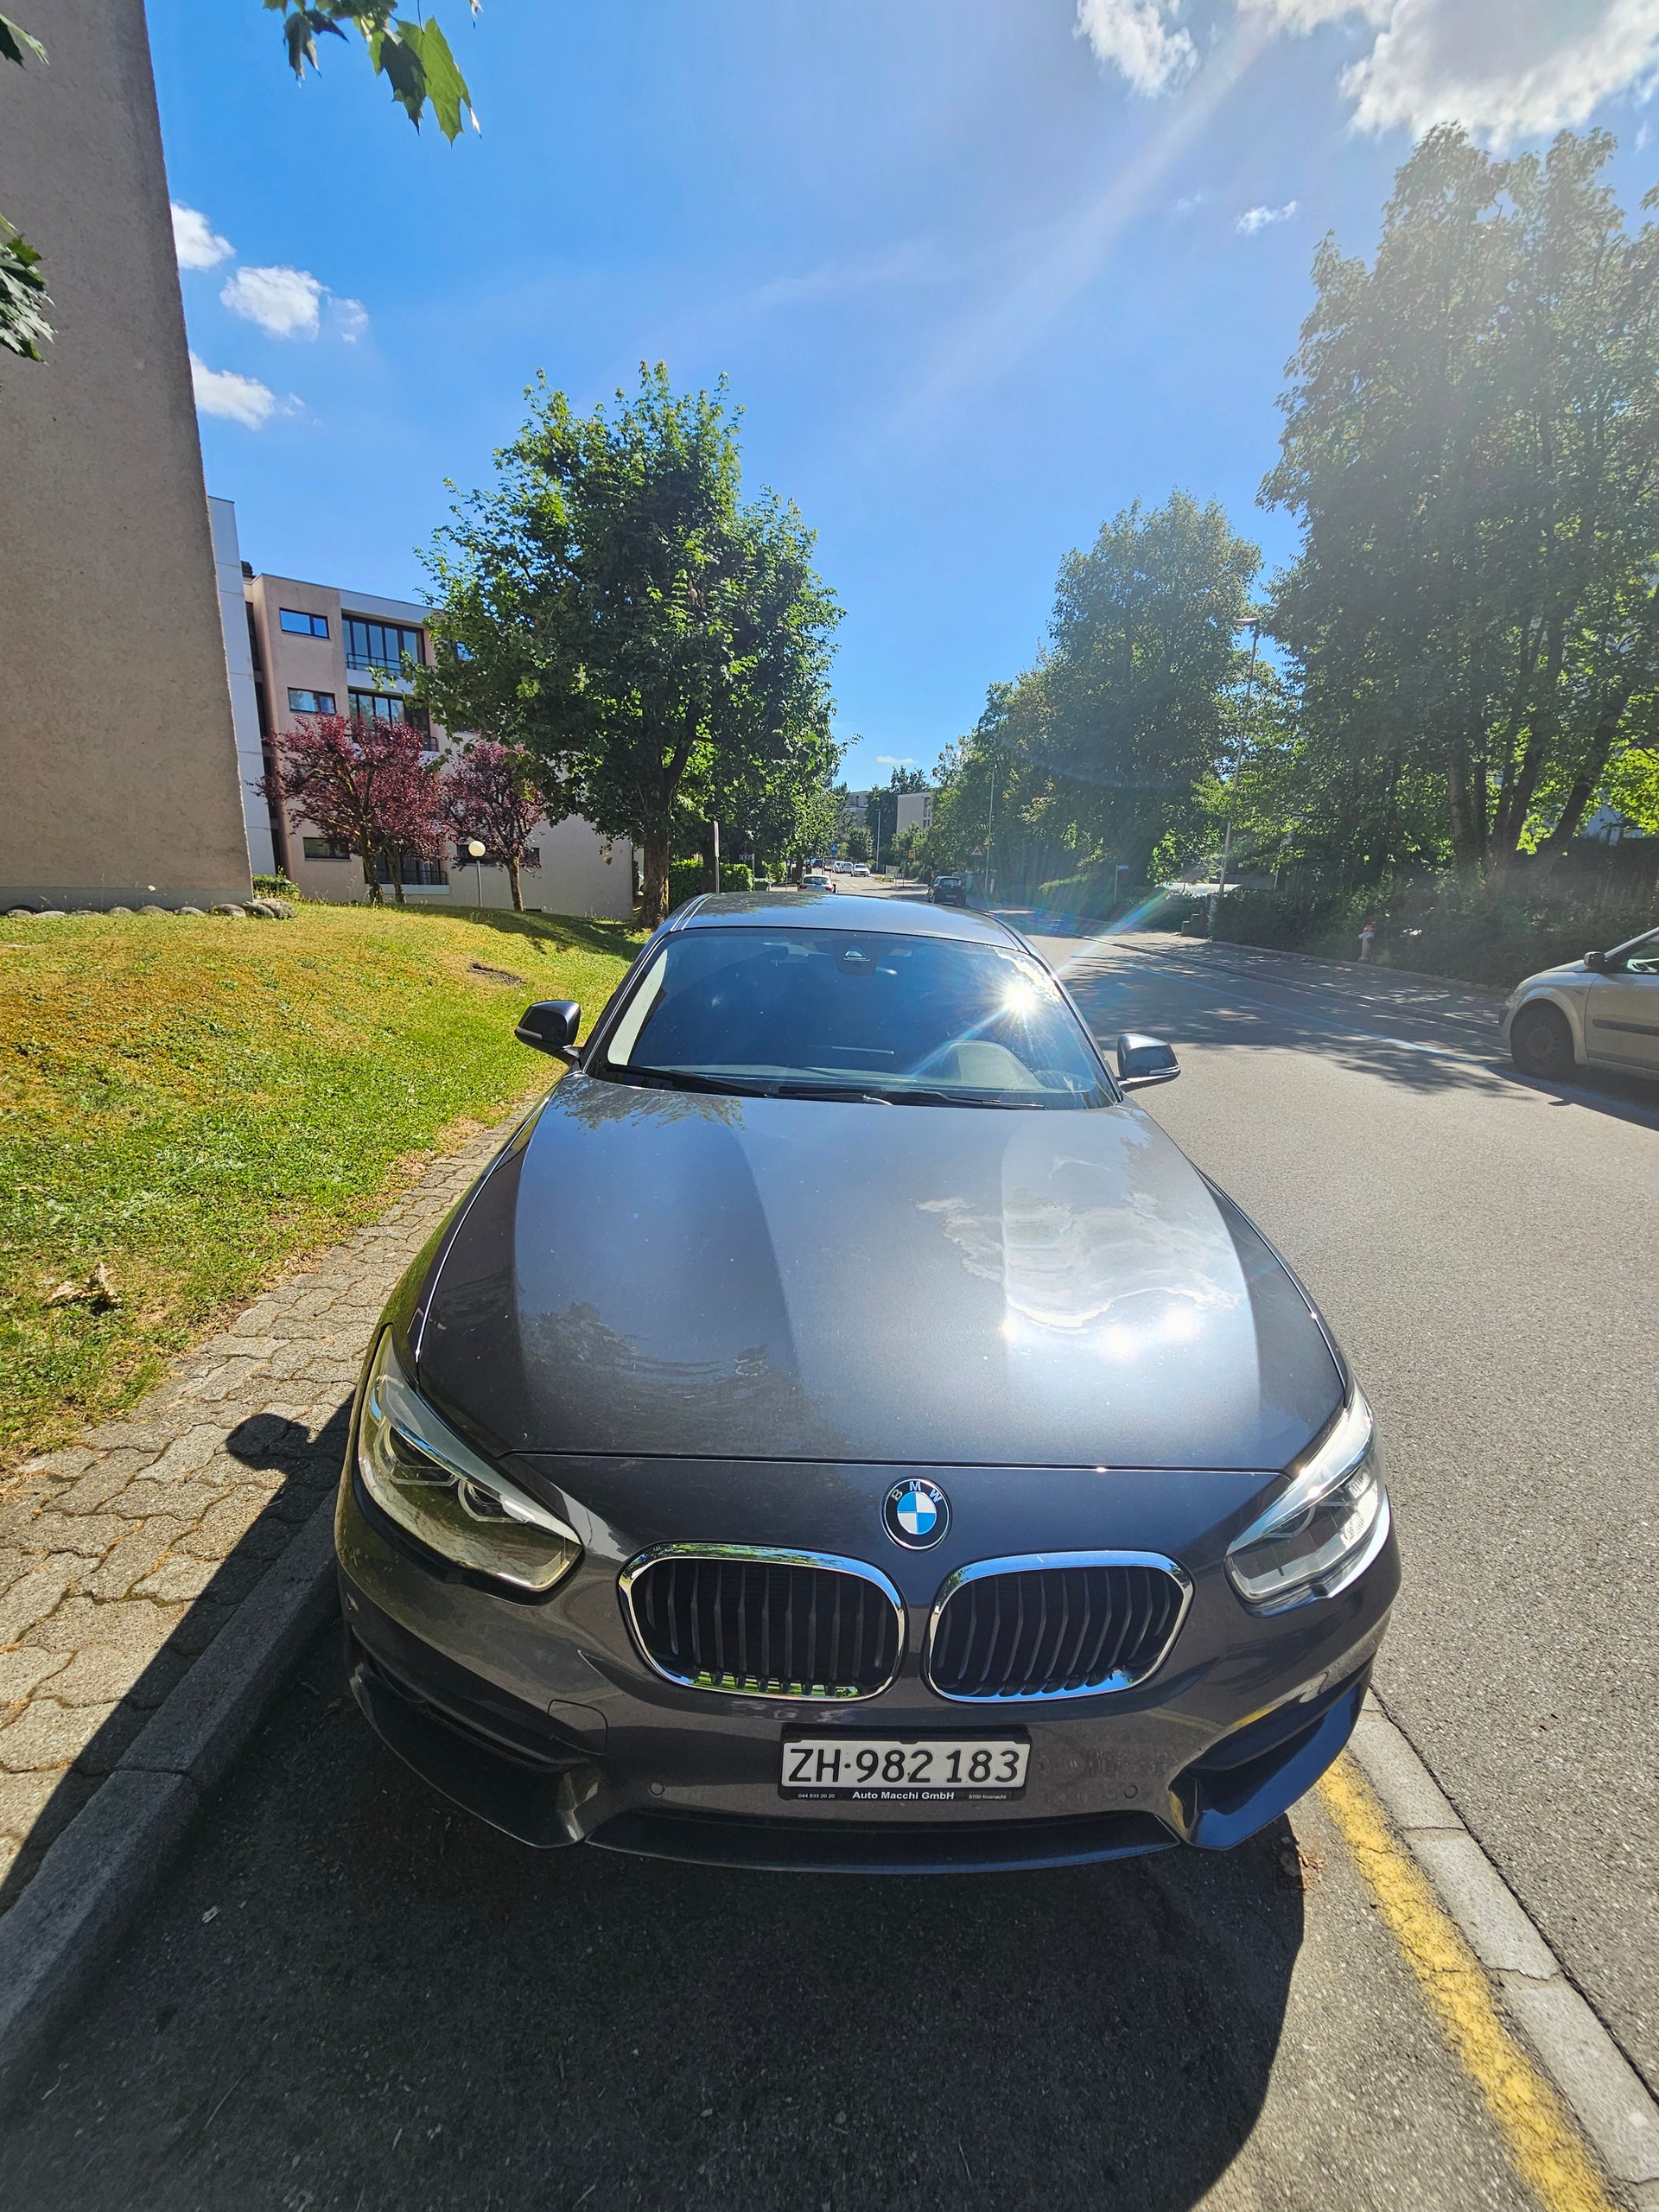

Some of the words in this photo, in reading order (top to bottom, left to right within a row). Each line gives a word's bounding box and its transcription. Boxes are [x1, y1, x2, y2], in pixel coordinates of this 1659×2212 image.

[890, 1480, 943, 1503] BMW
[880, 1791, 918, 1800] Macchi
[921, 1791, 955, 1800] GmbH
